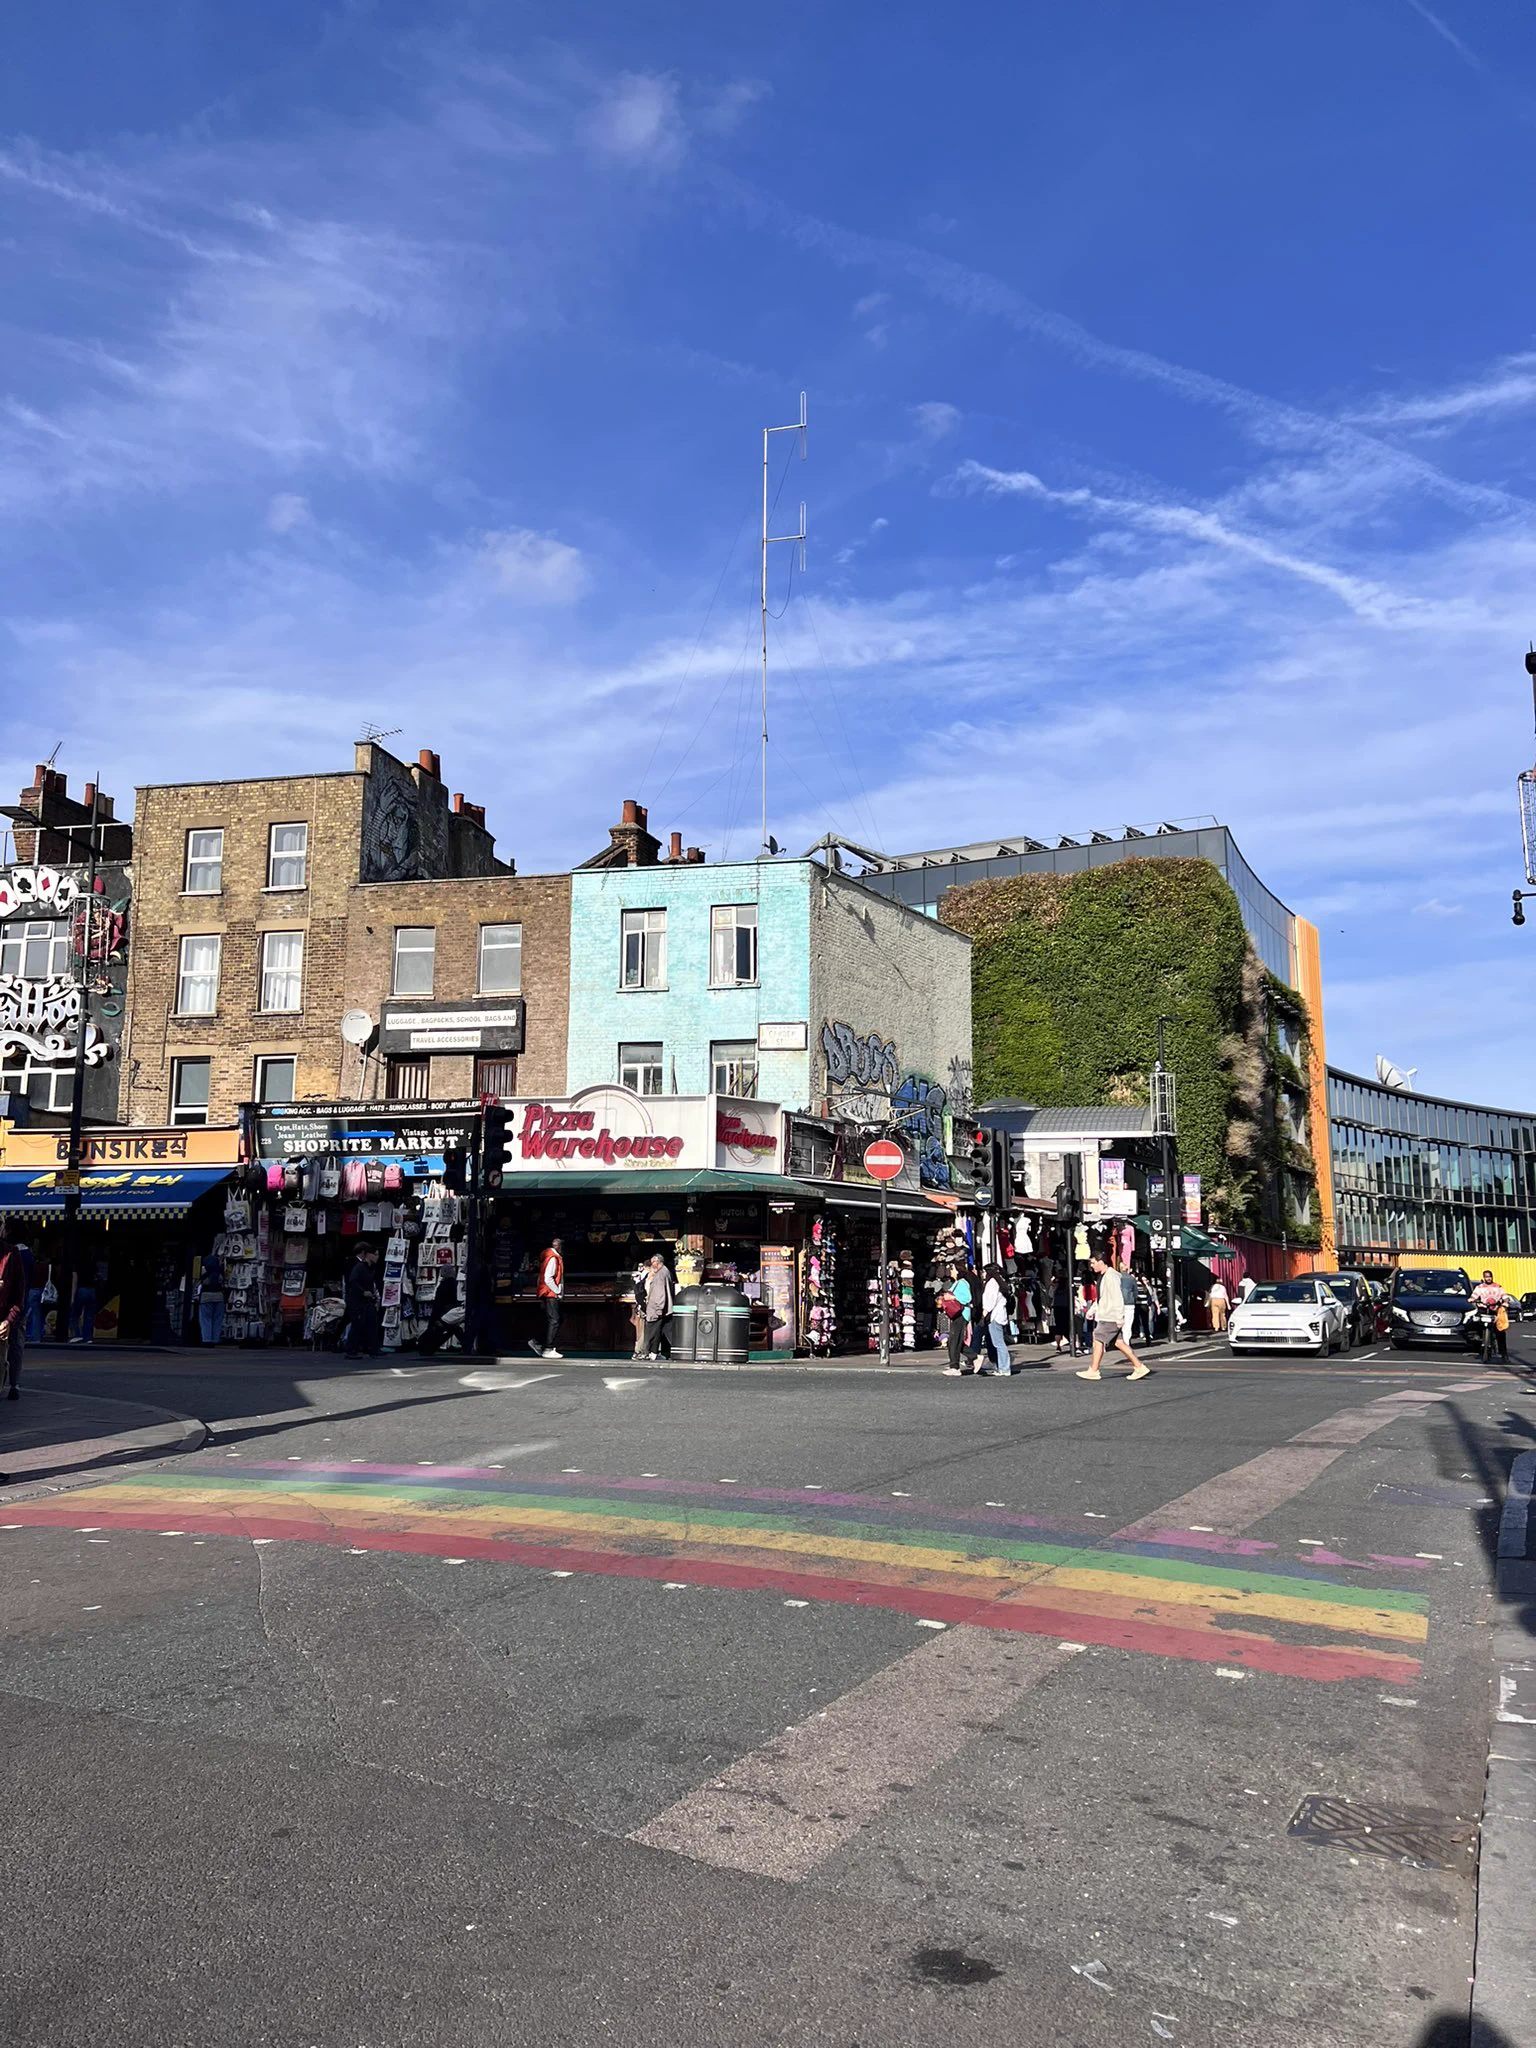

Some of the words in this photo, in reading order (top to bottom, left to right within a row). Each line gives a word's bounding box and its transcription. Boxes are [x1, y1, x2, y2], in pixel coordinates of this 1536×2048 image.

[0, 977, 80, 1032] attoo
[456, 1015, 482, 1023] SCHOOL
[484, 1014, 502, 1023] BAGS
[503, 1014, 517, 1022] AND
[412, 1036, 435, 1044] TRAVEL
[437, 1035, 480, 1043] ACCESSORIES
[338, 1105, 366, 1113] LUGGAGE
[388, 1102, 427, 1111] SUNGLASSES
[431, 1102, 448, 1110] BODY
[521, 1103, 595, 1132] Pizza
[301, 1131, 327, 1139] Leather
[402, 1128, 429, 1136] Vintage
[434, 1127, 464, 1136] Clothing
[283, 1138, 372, 1153] SHOPRITE
[380, 1135, 459, 1151] MARKET
[518, 1129, 684, 1165] Warehouse
